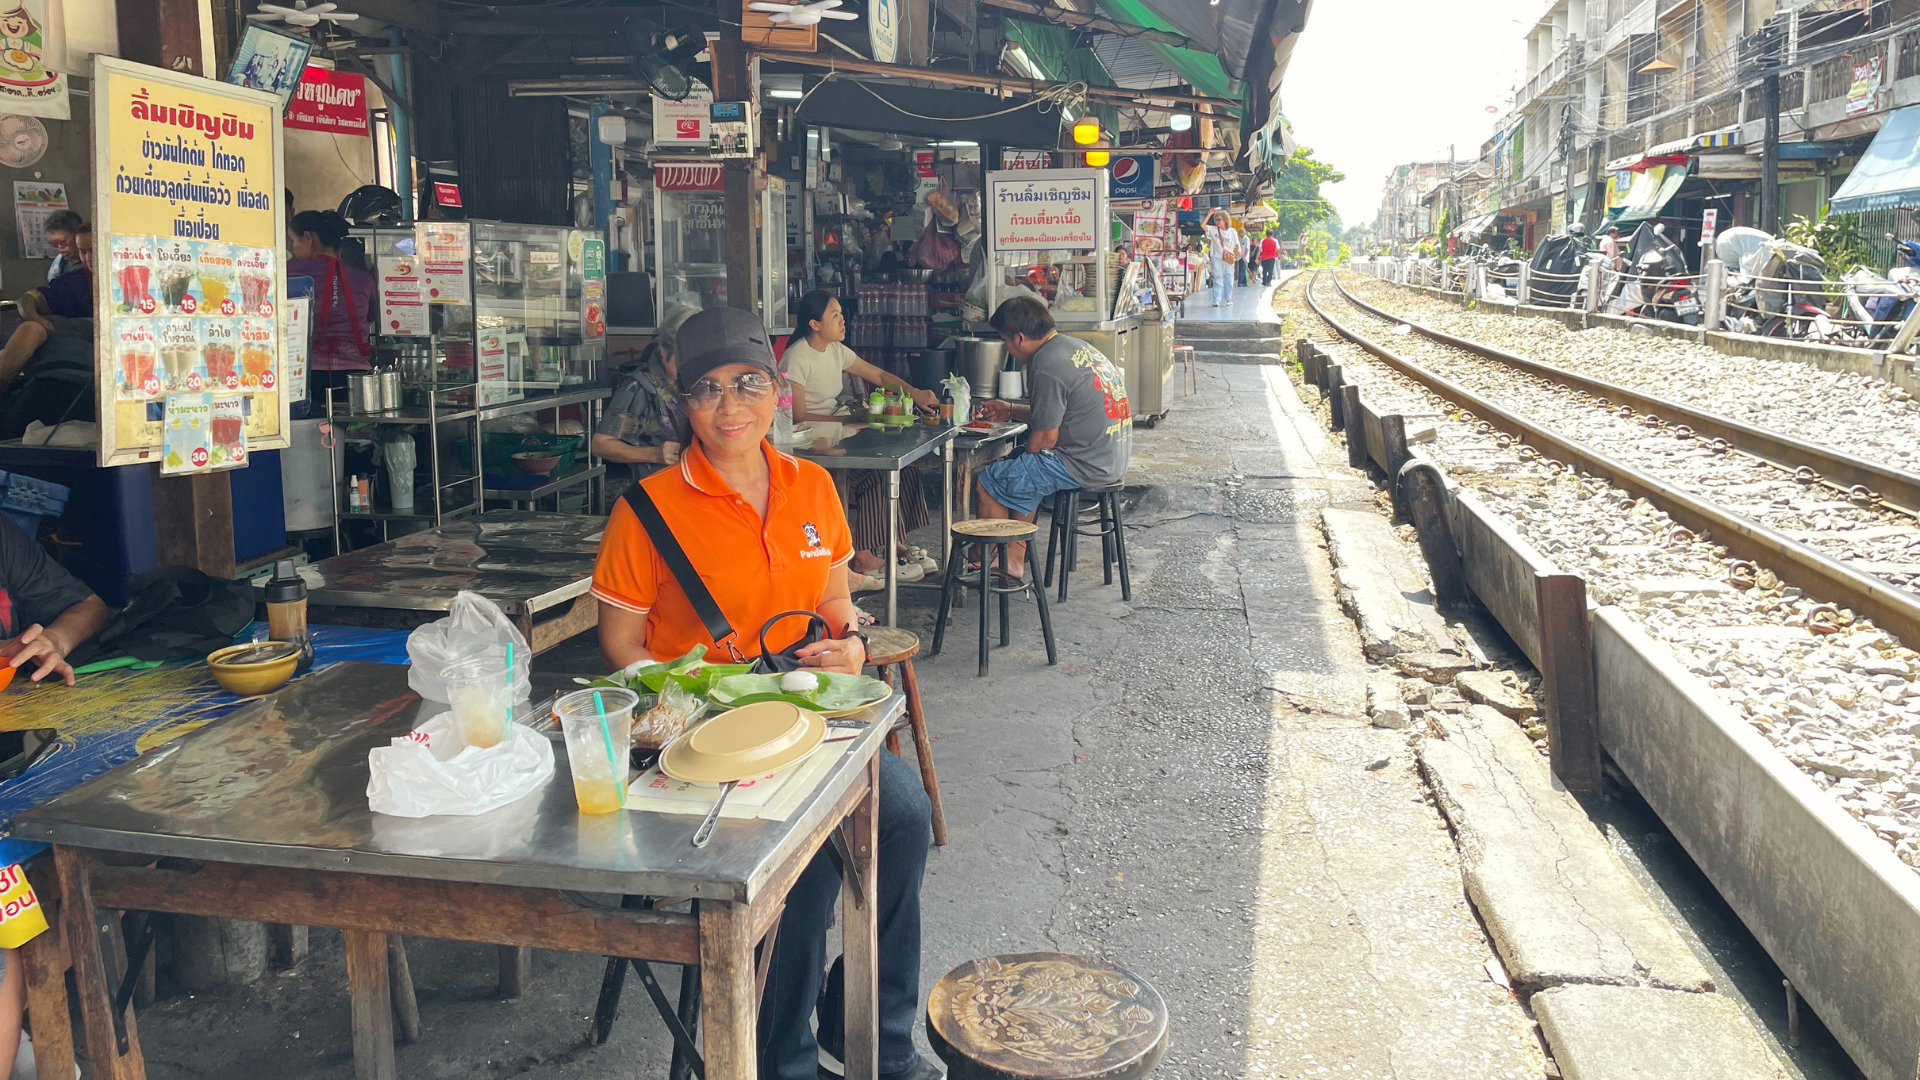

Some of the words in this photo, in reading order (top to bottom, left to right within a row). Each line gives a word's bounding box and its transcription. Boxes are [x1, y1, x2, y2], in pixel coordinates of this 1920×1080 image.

[131, 88, 254, 140] ลิ้มเชิญชิม
[211, 141, 245, 173] ไก่ทอด
[237, 178, 270, 211] เนื้อสด
[999, 183, 1091, 204] ร้านลิ้มเชิญชิม
[1114, 187, 1137, 195] pepsi
[1010, 208, 1081, 226] ก๋วยเตี๋ยวเนื้อ
[174, 206, 220, 240] เนื้อเปื่อย
[140, 299, 154, 310] 15
[182, 299, 195, 310] 15
[222, 302, 235, 313] 15
[259, 304, 271, 314] 20
[187, 377, 201, 387] 20
[226, 376, 238, 386] 25
[262, 374, 274, 384] 30
[144, 380, 158, 390] 20
[167, 398, 208, 414] น้ำมะนาว
[213, 400, 239, 410] มะนาว
[192, 452, 207, 462] 30
[232, 447, 244, 456] 30
